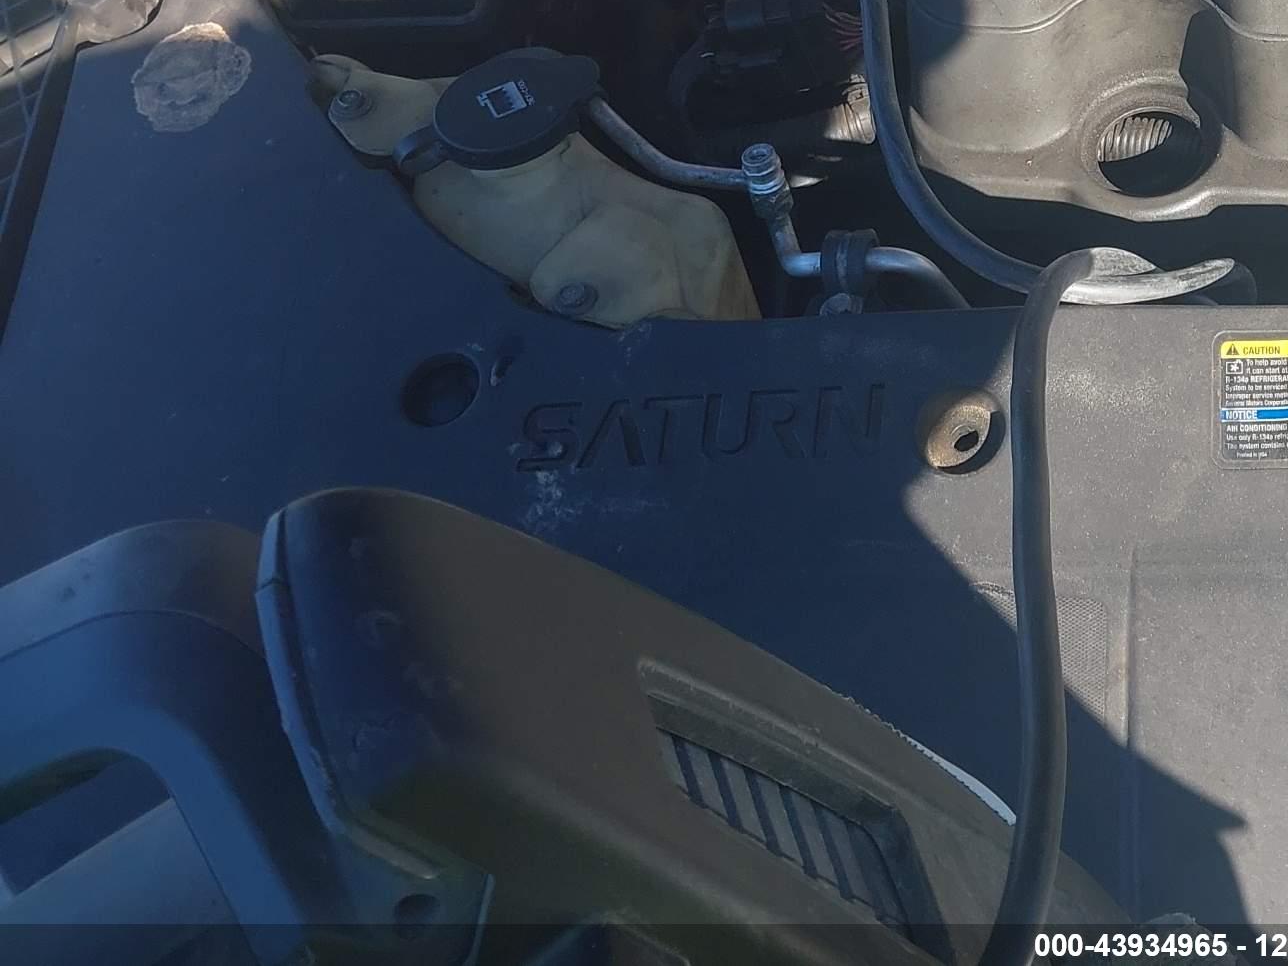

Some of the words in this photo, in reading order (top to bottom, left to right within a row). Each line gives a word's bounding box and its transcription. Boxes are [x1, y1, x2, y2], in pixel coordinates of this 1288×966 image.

[1243, 346, 1280, 355] CAUTION
[1255, 359, 1268, 367] help
[1270, 358, 1287, 366] avoid
[1226, 411, 1257, 420] NOTICE
[516, 384, 886, 472] SATURN
[1240, 424, 1287, 432] CONDITIONING
[1239, 434, 1251, 442] only
